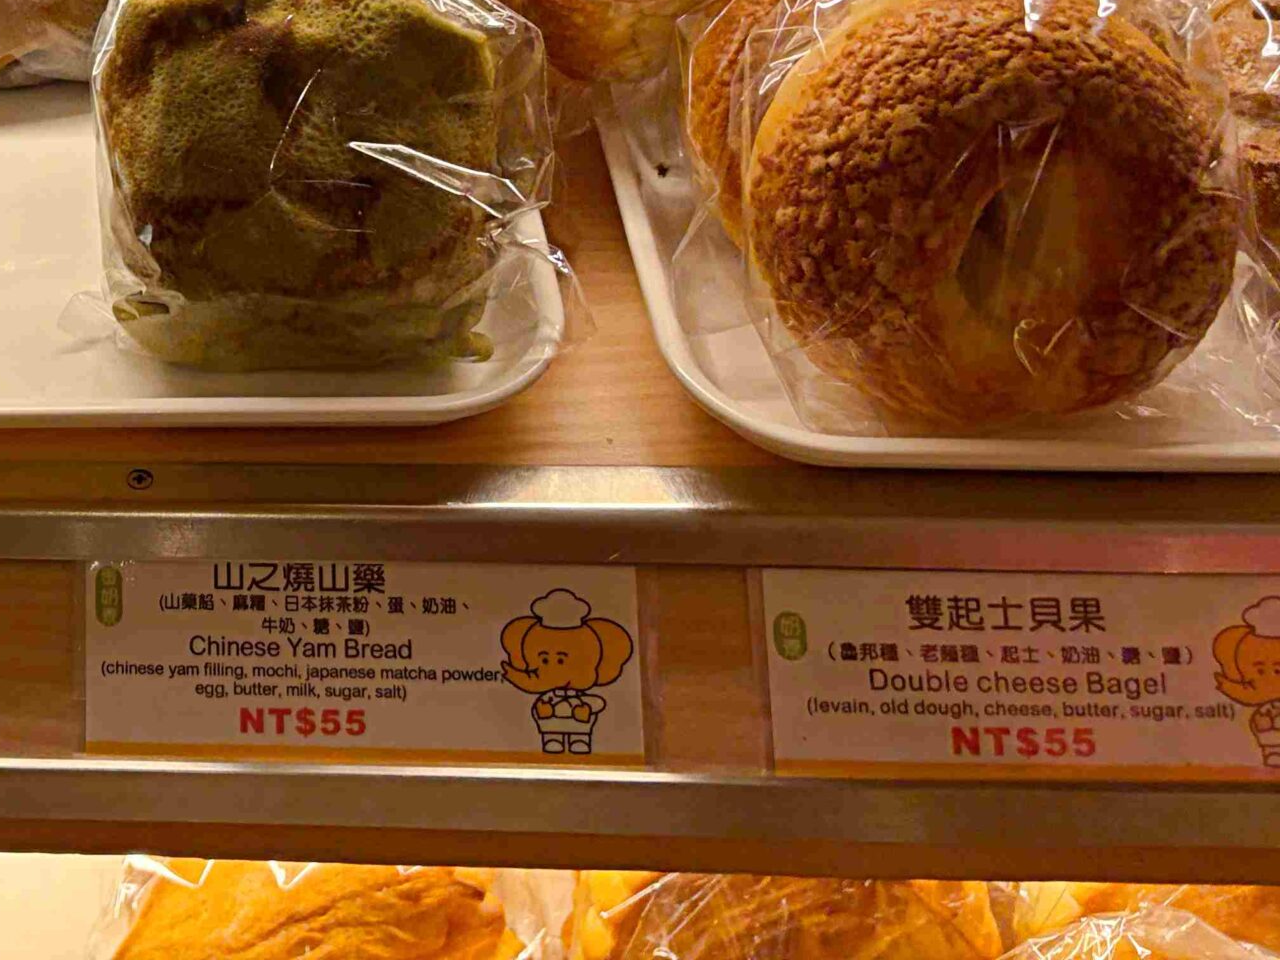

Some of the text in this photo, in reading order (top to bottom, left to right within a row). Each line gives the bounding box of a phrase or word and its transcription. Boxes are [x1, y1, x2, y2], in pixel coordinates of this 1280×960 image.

[905, 594, 1107, 633] 雙起士貝果
[189, 635, 412, 659] Chinese Yam Bread
[101, 660, 164, 677] (chinese
[169, 664, 199, 679] yam
[204, 662, 248, 680] filling,
[252, 663, 302, 680] mochi,
[305, 665, 376, 681] japanese
[380, 666, 437, 680] matcha
[869, 668, 1166, 700] Double cheese Bagel
[195, 681, 407, 701] egg, butter, milk, sugar, salt)
[239, 707, 367, 737] NT$55
[807, 696, 875, 716] (levain,
[879, 699, 909, 715] old
[914, 699, 979, 719] dough,
[984, 701, 1057, 718] cheese,
[1195, 703, 1236, 721] salt)
[951, 725, 1096, 758] NT$55
